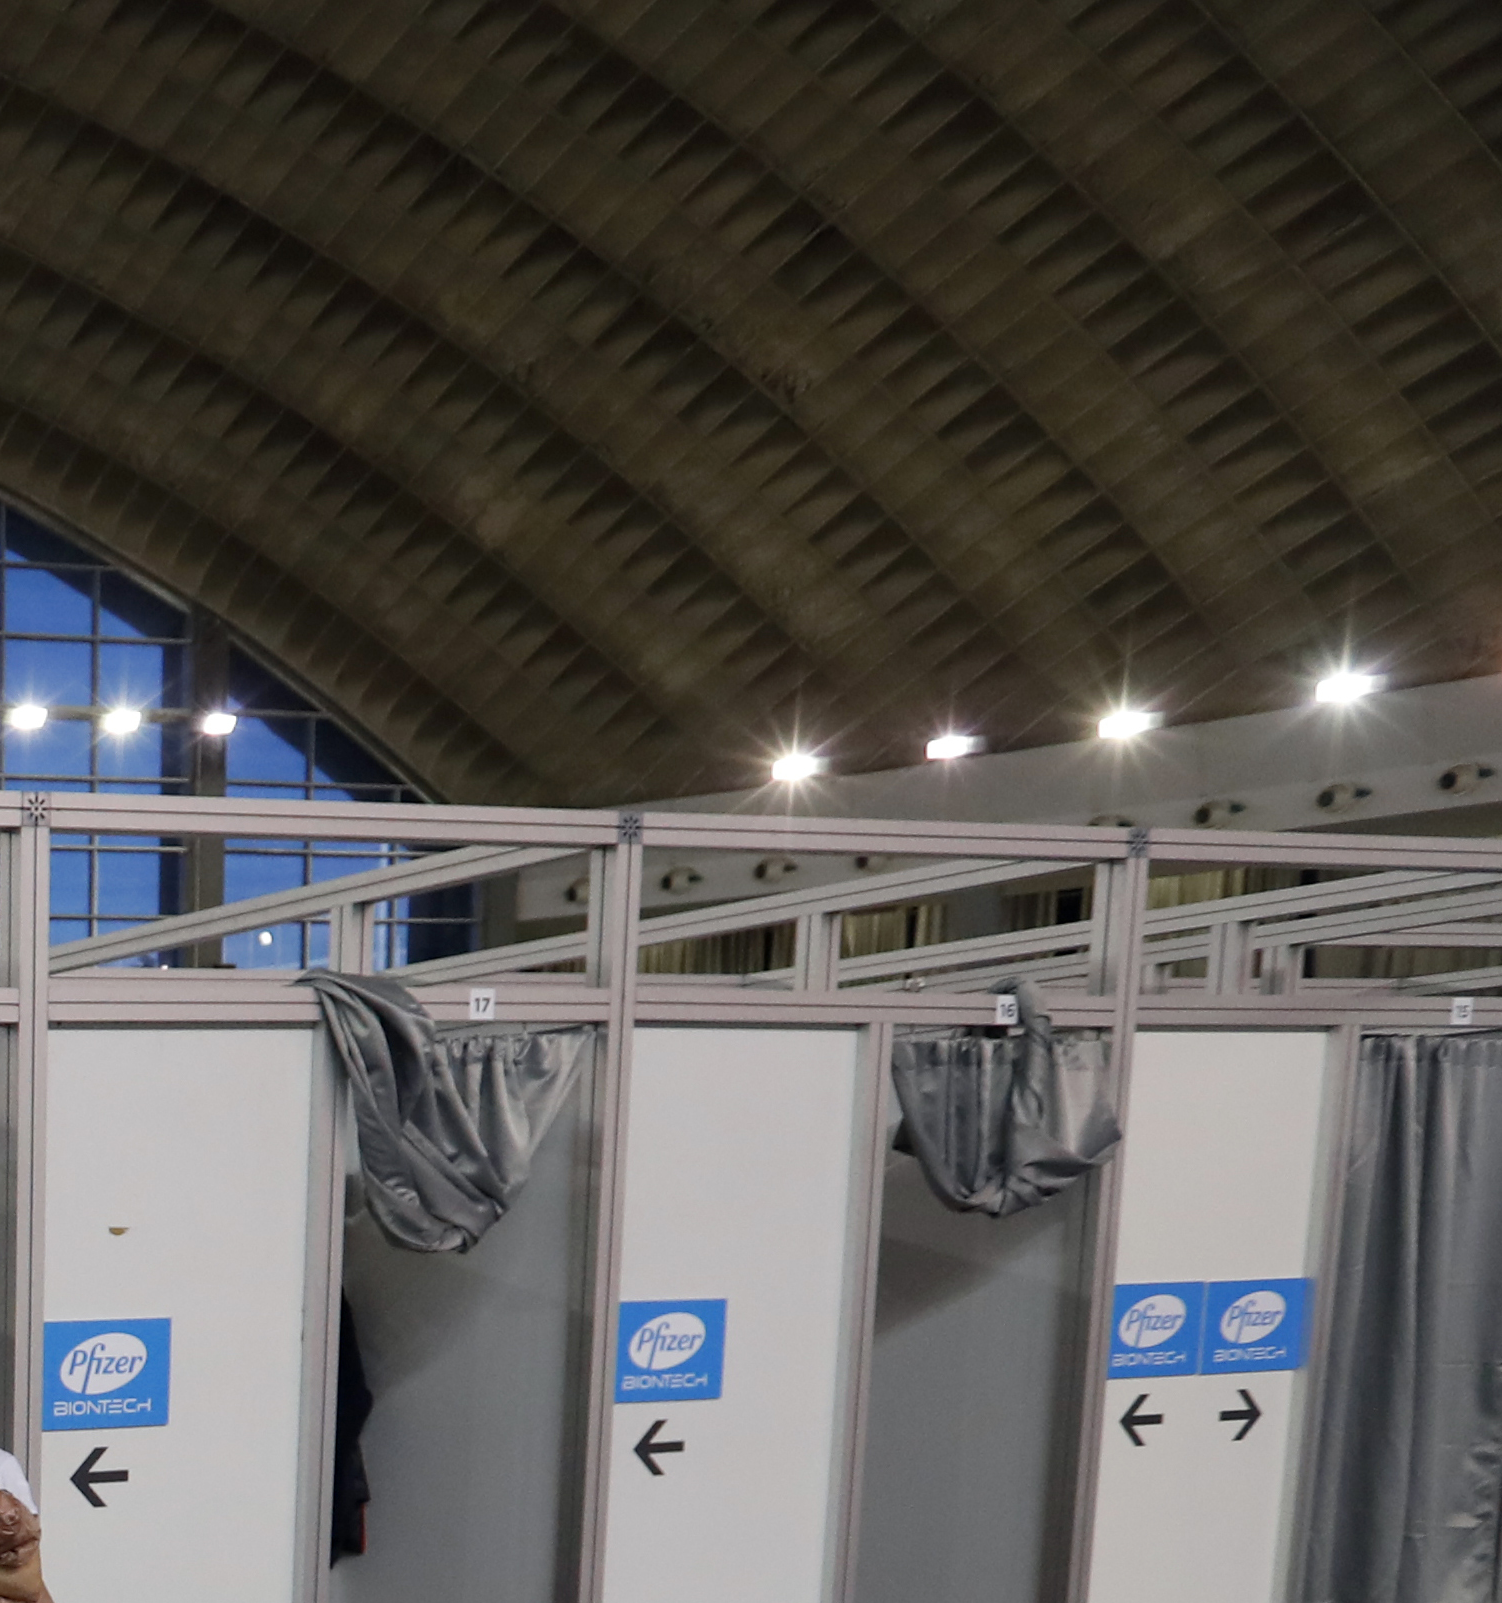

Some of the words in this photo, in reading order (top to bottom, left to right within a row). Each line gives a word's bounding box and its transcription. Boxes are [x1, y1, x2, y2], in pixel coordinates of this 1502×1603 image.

[475, 997, 491, 1012] 17
[1125, 1303, 1182, 1347] Pfizer
[1227, 1299, 1282, 1343] Pfizer
[637, 1321, 702, 1369] Pfizer
[68, 1342, 143, 1394] Pfizer
[622, 1373, 709, 1391] BIONTECH
[54, 1398, 152, 1416] BIONTECH
